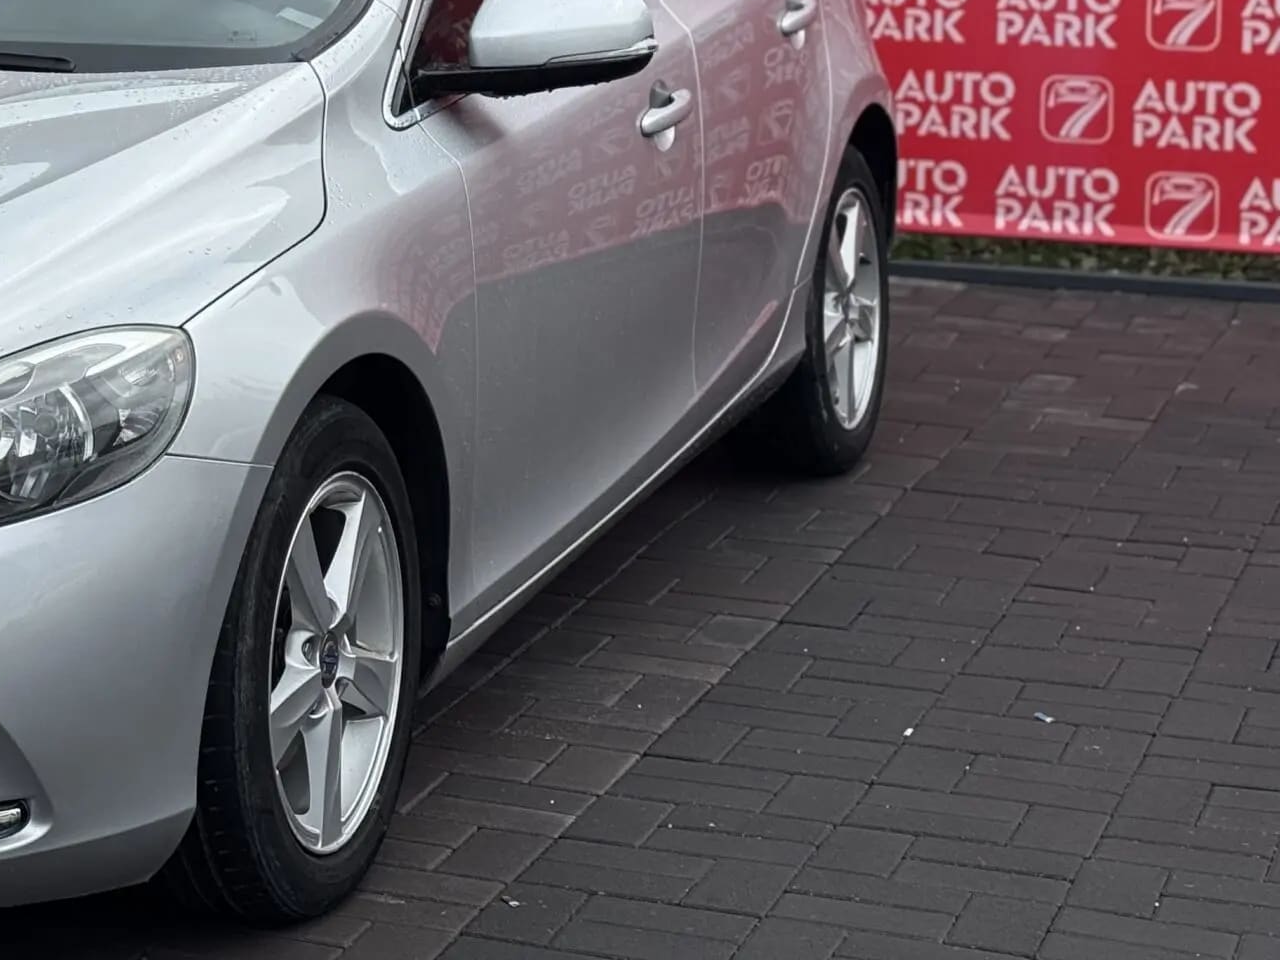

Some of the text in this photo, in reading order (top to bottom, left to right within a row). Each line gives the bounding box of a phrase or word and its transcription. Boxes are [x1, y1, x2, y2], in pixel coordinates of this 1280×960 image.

[997, 11, 1116, 48] PARK
[895, 70, 1015, 106] AUTO
[1134, 80, 1260, 117] AUTO
[896, 104, 1012, 140] PARK
[1134, 113, 1255, 152] PARK
[996, 166, 1119, 201] AUTO
[995, 198, 1115, 237] PARK
